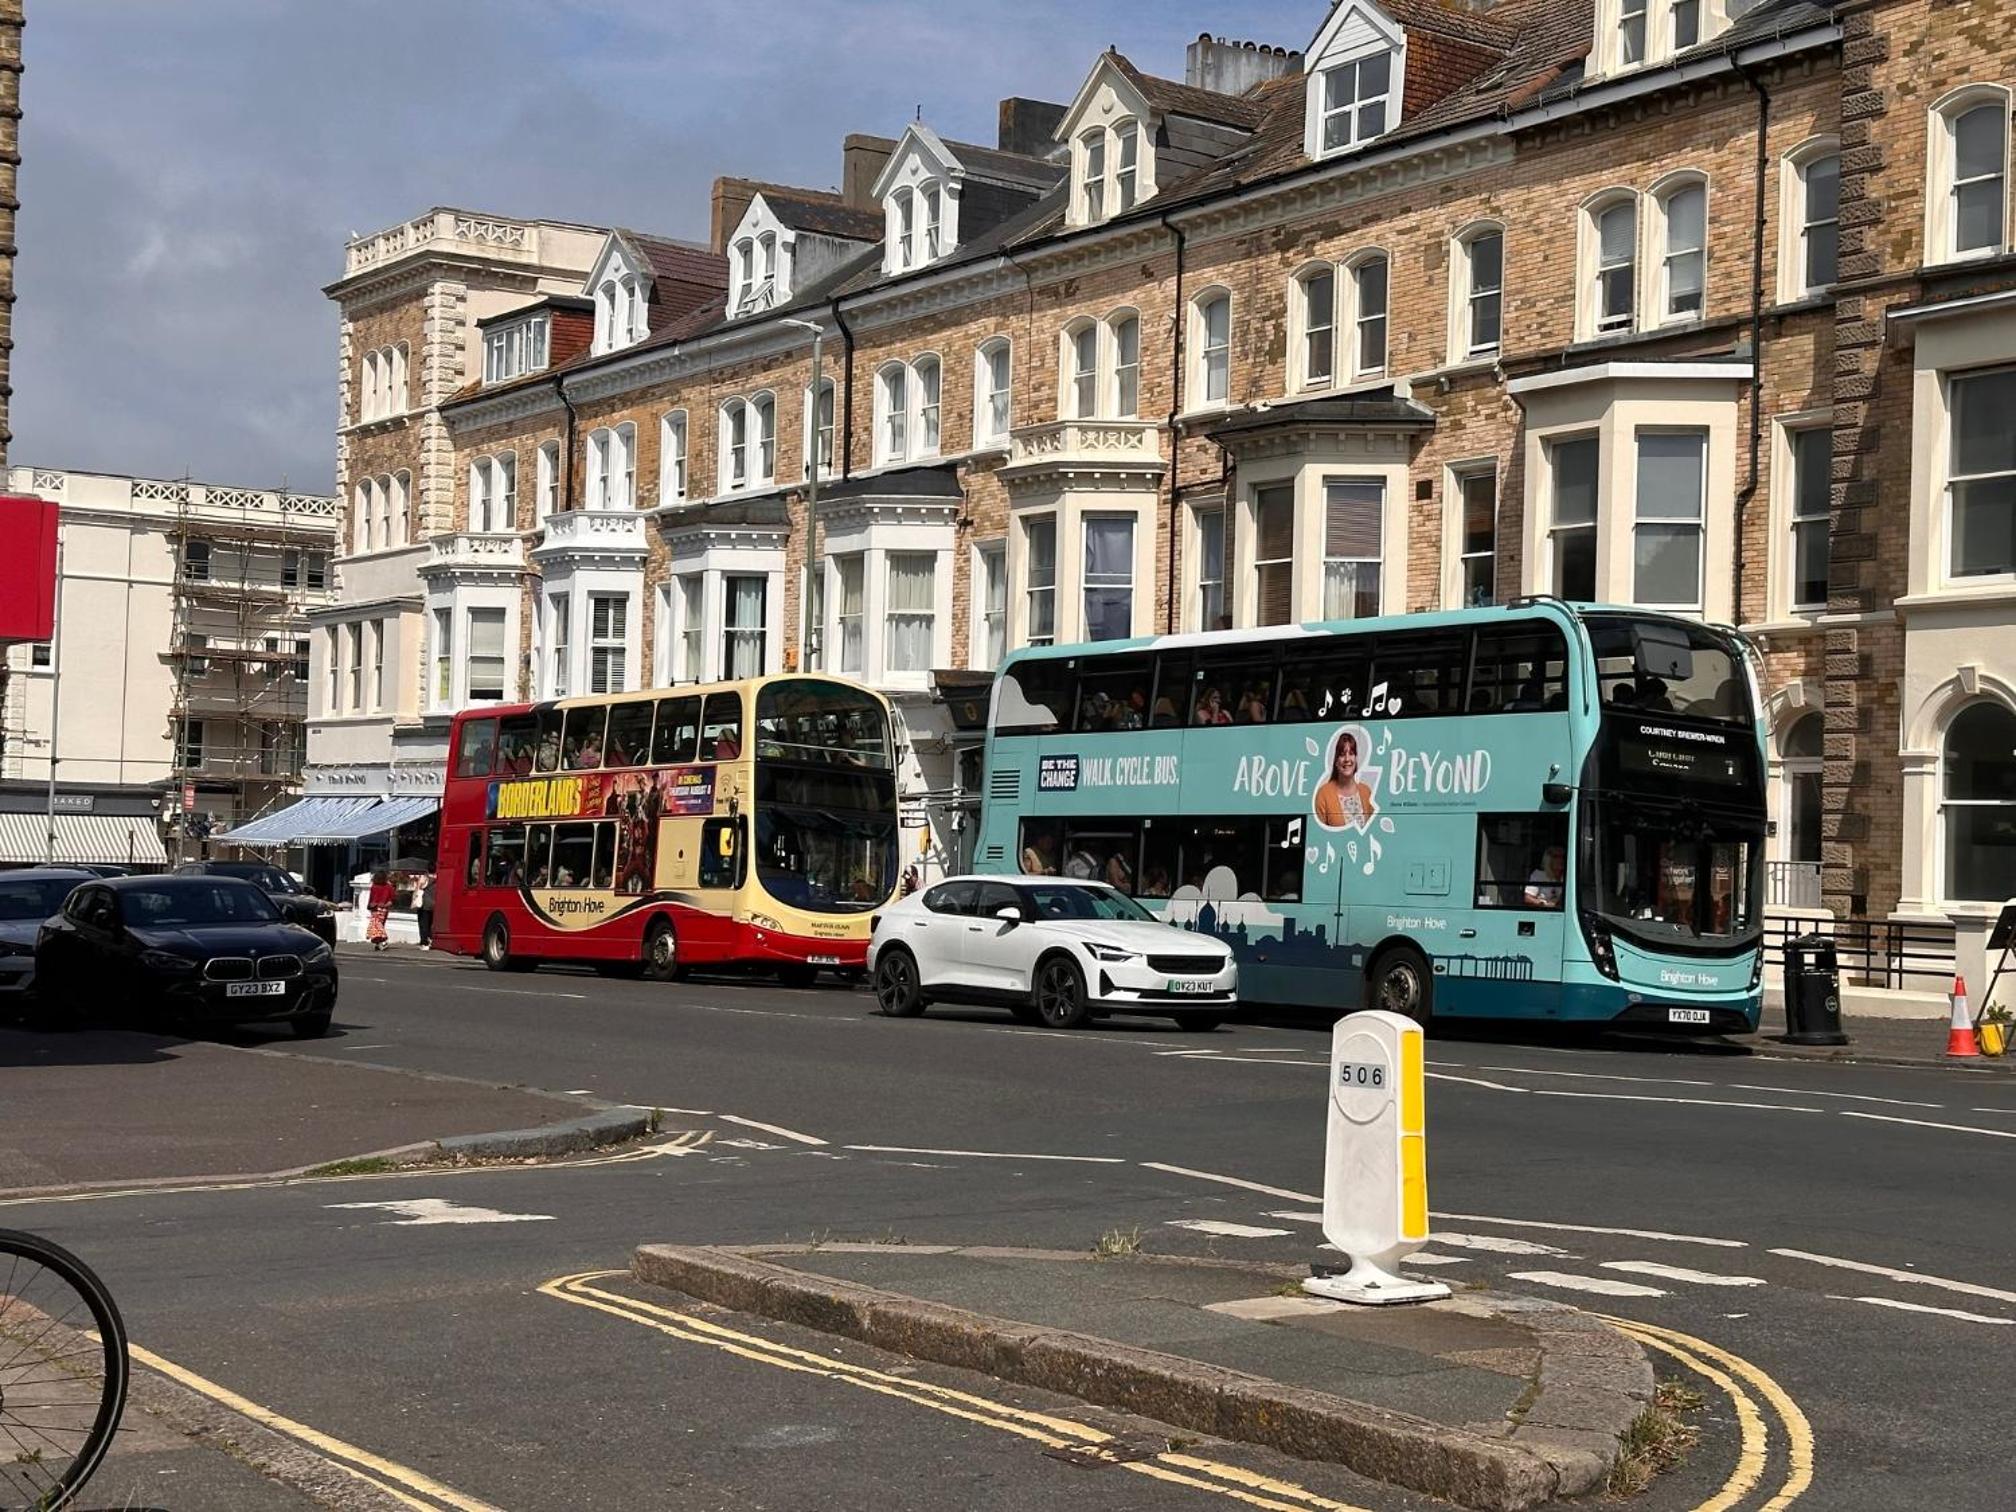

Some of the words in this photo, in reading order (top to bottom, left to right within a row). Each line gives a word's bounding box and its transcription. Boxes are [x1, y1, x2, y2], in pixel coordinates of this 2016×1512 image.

[1041, 760, 1054, 769] BE
[1057, 759, 1077, 769] THE
[1082, 758, 1113, 786] WALK.
[1116, 756, 1151, 785] CYCLE.
[1154, 755, 1179, 785] BUS.
[1040, 770, 1076, 787] CHANGE
[1233, 755, 1311, 797] ABOVE
[1389, 749, 1492, 795] BEYOND
[497, 779, 583, 818] BORDERLANDS
[549, 897, 581, 916] Brighton
[584, 897, 604, 913] Hove
[1387, 915, 1421, 931] Brighton
[1425, 916, 1447, 929] Hove
[1198, 981, 1212, 991] KUT
[1661, 970, 1695, 985] Brighton
[1698, 973, 1718, 986] Hove
[261, 983, 281, 993] BXZ
